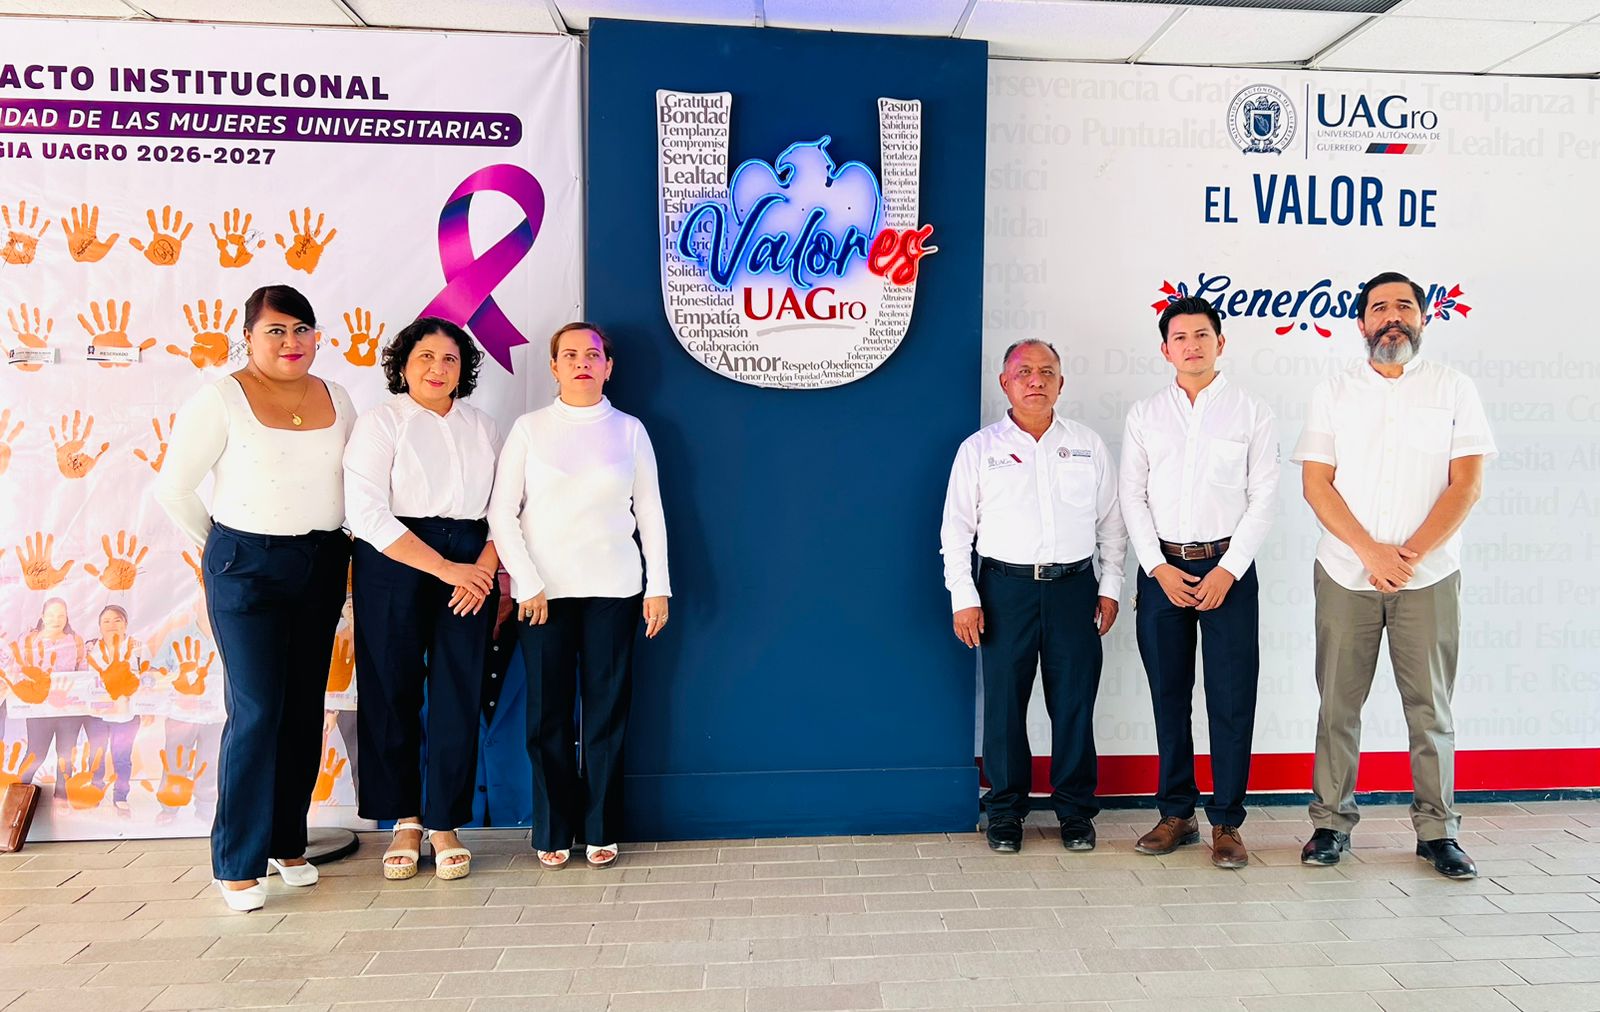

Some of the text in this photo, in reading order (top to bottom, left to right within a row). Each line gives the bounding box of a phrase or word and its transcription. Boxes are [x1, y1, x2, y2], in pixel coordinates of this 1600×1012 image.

[110, 67, 389, 100] INSTITUCIONAL
[664, 93, 723, 109] Gratitud
[1420, 82, 1575, 122] Templanza
[660, 106, 729, 124] Bondad
[1317, 93, 1438, 130] UAGro
[68, 109, 102, 129] DE
[111, 111, 160, 131] LAS
[169, 112, 287, 135] MUJERES
[296, 116, 511, 141] UNIVERSITARIAS:
[661, 124, 727, 140] Templanza
[882, 130, 919, 140] Sacrificio
[1317, 129, 1441, 140] UNIVERSIDAD AUTÓNOMA DE
[1447, 126, 1545, 157] Lealtad
[42, 142, 127, 161] UAGRO
[137, 144, 276, 165] 2026-2027
[882, 140, 919, 151] Servicio
[1316, 143, 1362, 152] GUERRERO
[663, 149, 726, 165] Servicio
[883, 152, 918, 161] Fortaleza
[884, 168, 917, 177] Felicidad
[884, 179, 918, 188] Disciplina
[662, 187, 728, 200] Puntualidad
[1204, 172, 1438, 228] EL VALOR DE
[677, 193, 939, 288] Valores
[670, 295, 734, 306] Honestidad
[743, 286, 867, 320] UAGro
[674, 308, 740, 329] Empatía
[679, 325, 748, 341] Compasión
[869, 326, 906, 337] Rectitud
[687, 341, 759, 352] Colaboración
[704, 350, 874, 373] Fe Amor Respeto Obediencia
[734, 373, 761, 381] Honor
[763, 373, 792, 382] Perdón
[794, 373, 820, 382] Equidad
[820, 370, 855, 379] Amistad
[1505, 664, 1539, 693] Fe
